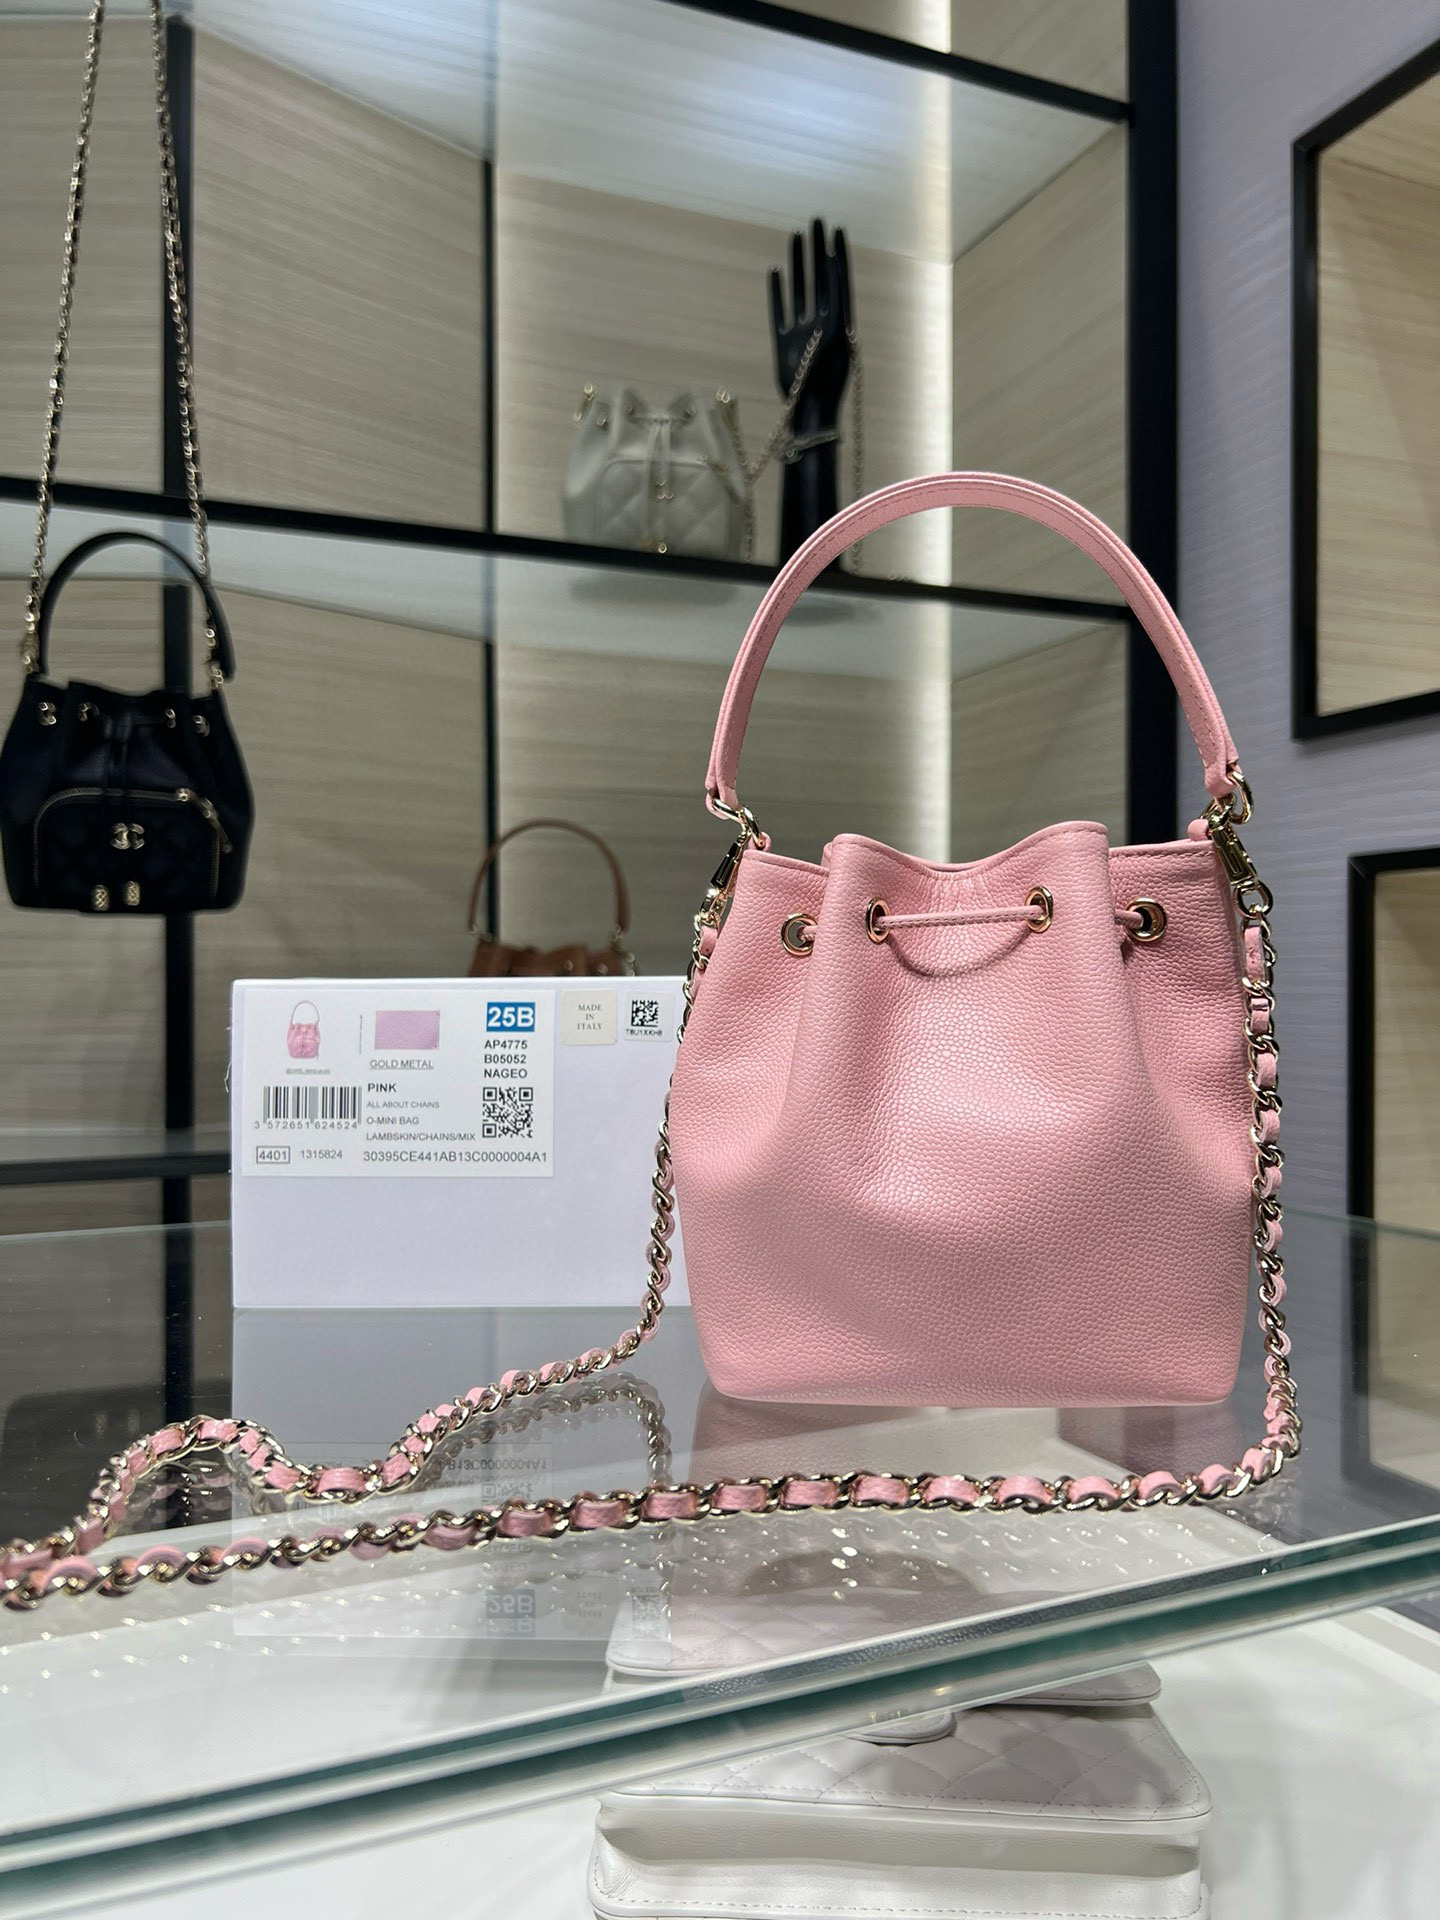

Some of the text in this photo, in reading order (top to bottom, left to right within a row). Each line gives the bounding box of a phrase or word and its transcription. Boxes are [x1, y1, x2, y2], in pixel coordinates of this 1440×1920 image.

[487, 1006, 534, 1028] 25B
[484, 1039, 528, 1050] AP4775
[370, 1059, 433, 1068] GOLD METAL
[484, 1054, 527, 1064] B05052
[367, 1083, 397, 1093] PINK
[367, 1101, 440, 1109] ALL ABOUT CHAINS
[366, 1117, 420, 1125] O-MINI BAG
[366, 1133, 476, 1142] LAMBSKIN/CHAINS/MIX
[258, 1150, 288, 1161] 4401
[300, 1149, 343, 1159] 1315824
[363, 1151, 547, 1163] 30395CE441AB13C0000004A1
